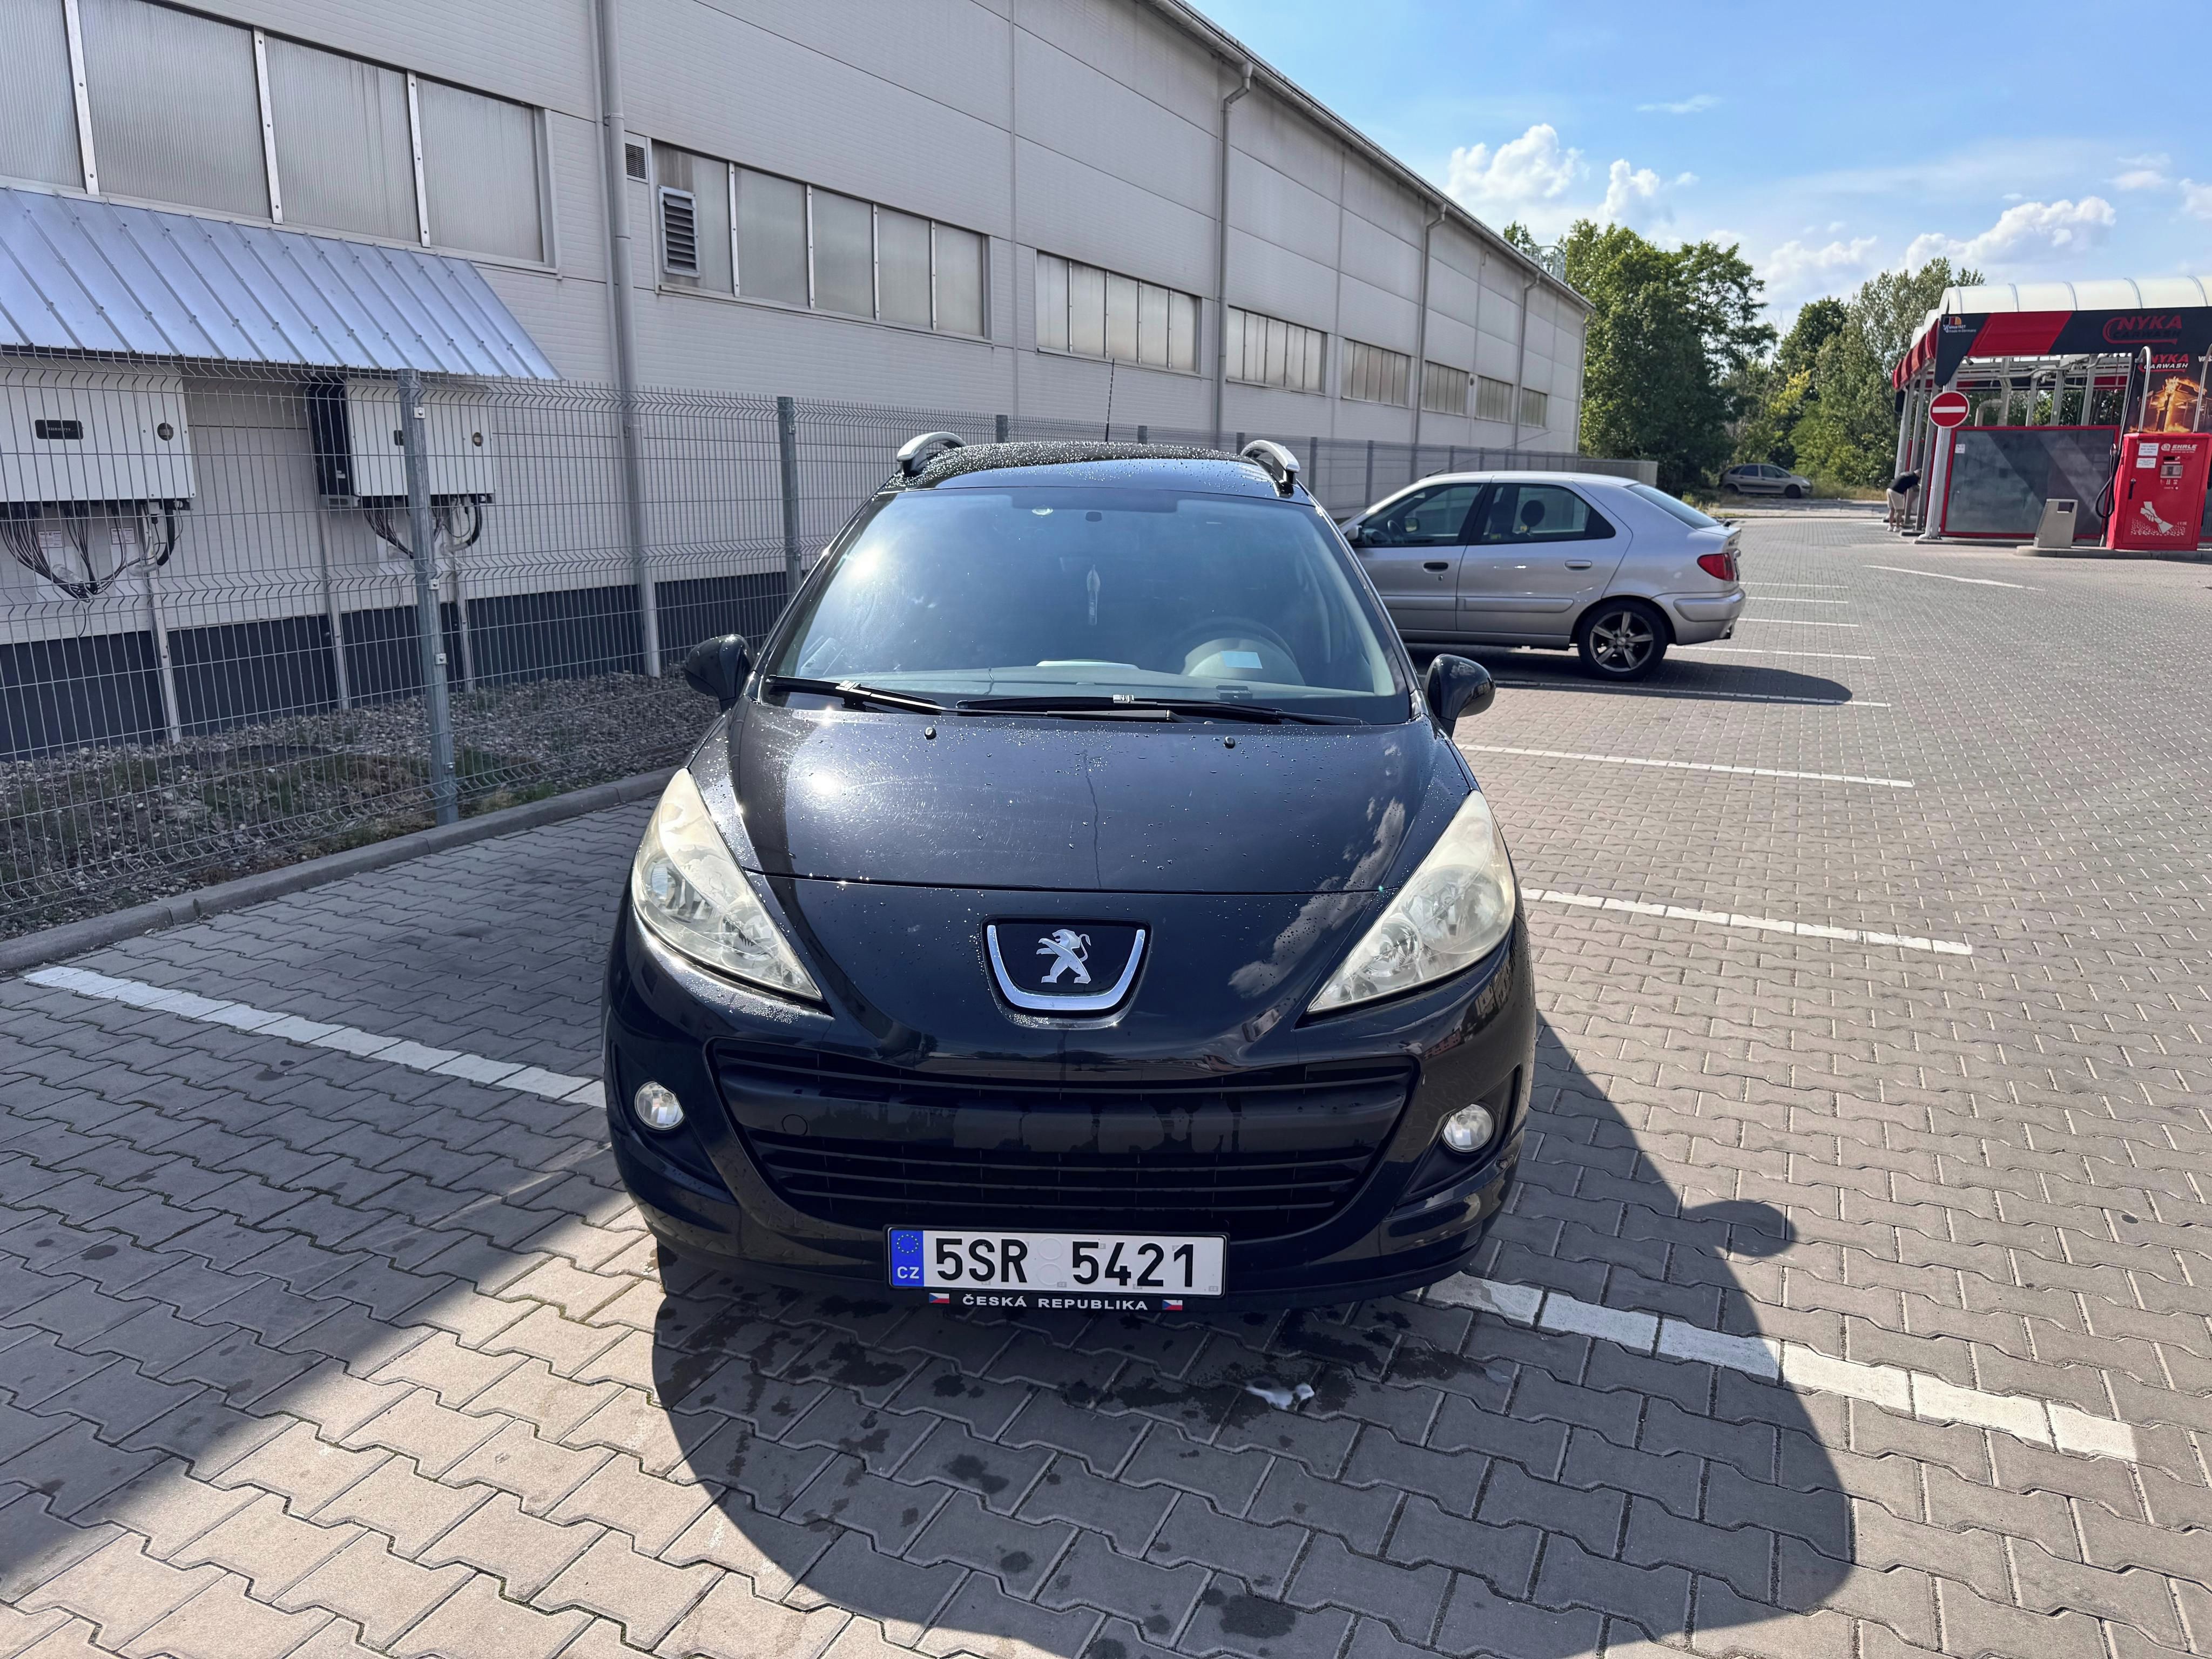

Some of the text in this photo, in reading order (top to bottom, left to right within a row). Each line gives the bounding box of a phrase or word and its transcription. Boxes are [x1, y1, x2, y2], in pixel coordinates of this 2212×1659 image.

[2117, 315, 2182, 329] NYKA
[2113, 330, 2182, 339] CARWASH
[2148, 354, 2189, 363] NYKA
[936, 1237, 1193, 1287] 5SR 5421
[897, 1266, 919, 1279] CZ
[962, 1294, 1148, 1311] ČESKÁ REPUBLIKA
